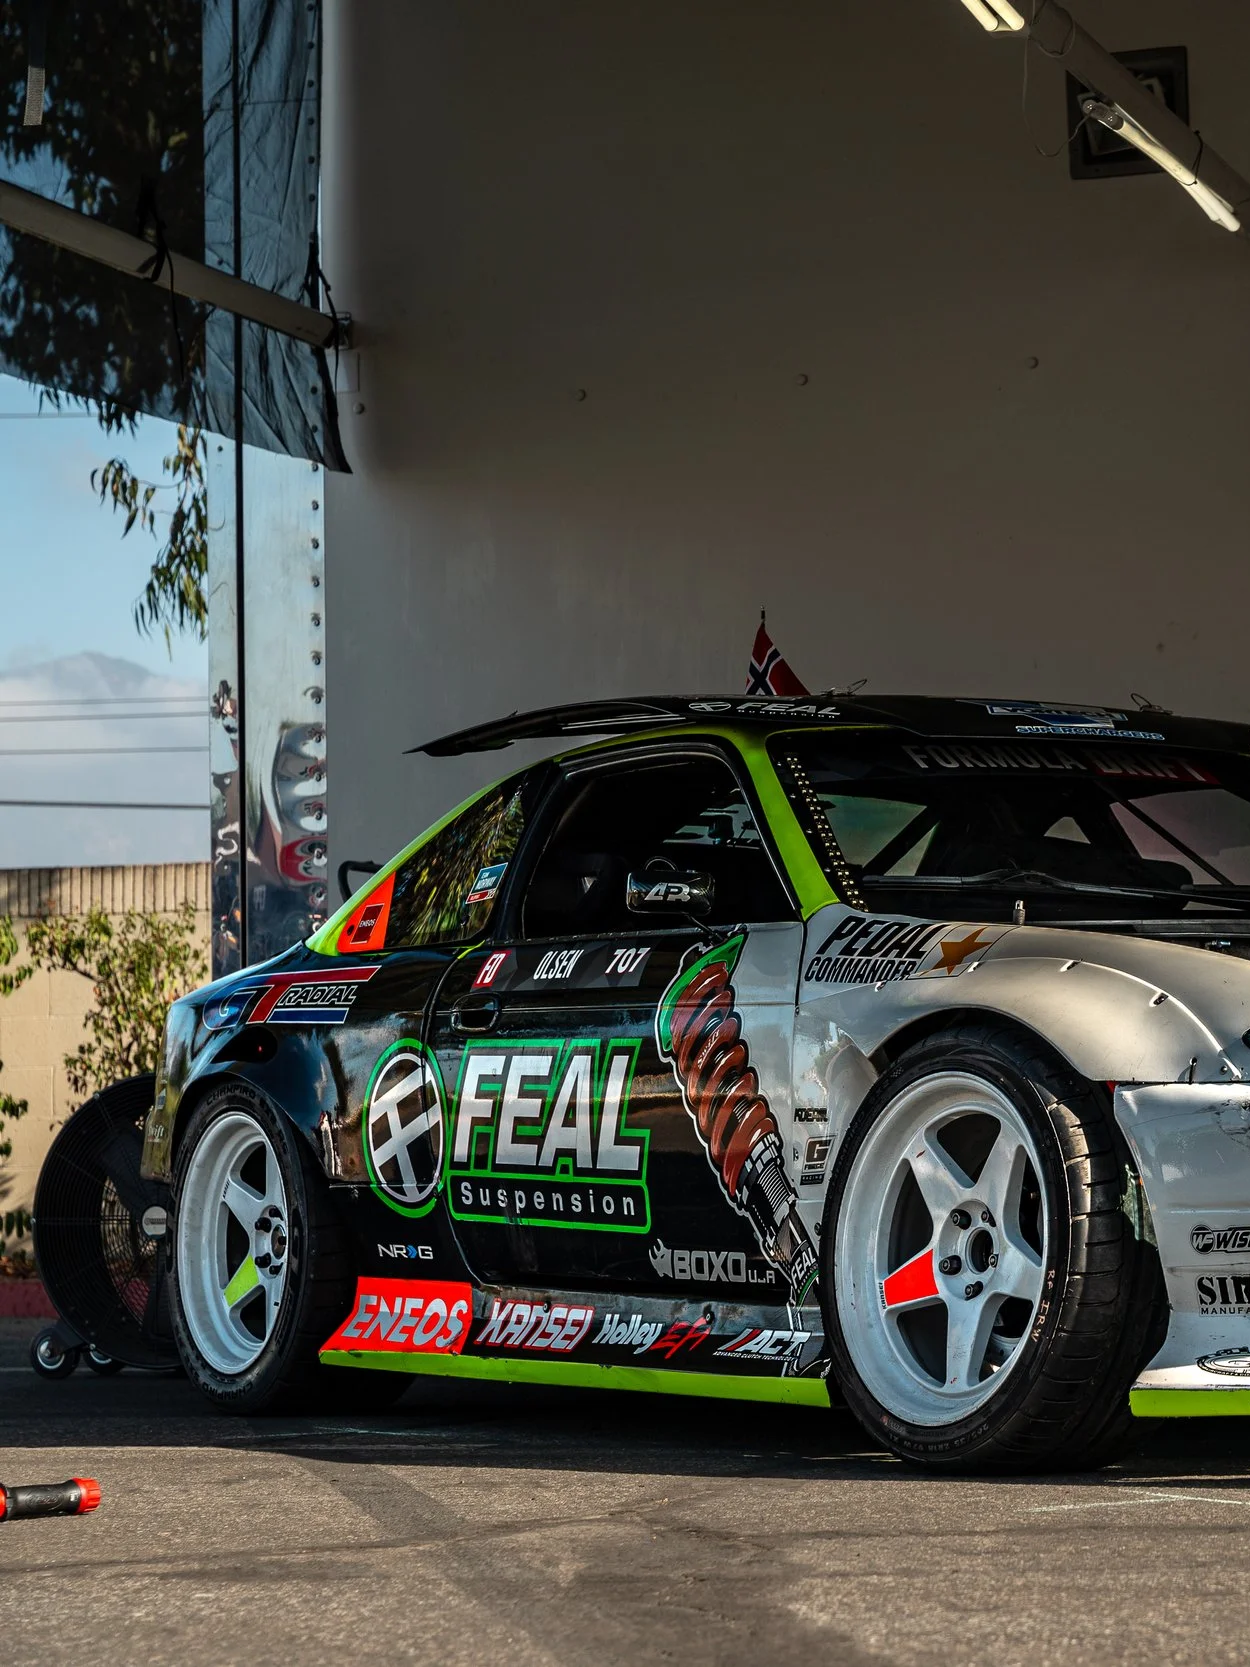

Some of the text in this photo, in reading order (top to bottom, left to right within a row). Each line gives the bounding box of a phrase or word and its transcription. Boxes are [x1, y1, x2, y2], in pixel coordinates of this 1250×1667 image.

[736, 702, 841, 716] FEAL
[1015, 725, 1166, 740] SUPERCHARGERS
[901, 744, 1207, 782] FORMULA DRIFT
[358, 918, 376, 929] ENEOS
[816, 915, 951, 959] PEDAL
[476, 947, 651, 984] FD OLSEN 707
[804, 957, 918, 984] COMMANDER
[203, 965, 382, 1031] GT RADIAL
[206, 1083, 257, 1106] CHAMPIRO
[454, 1055, 641, 1171] FEAL
[461, 1181, 635, 1216] Suspension
[673, 1250, 747, 1283] BOXO
[791, 1247, 816, 1289] FEAL
[345, 1294, 469, 1348] ENEOS
[475, 1299, 594, 1350] KANSEI
[592, 1313, 663, 1355] Holley
[732, 1329, 812, 1356] ACT
